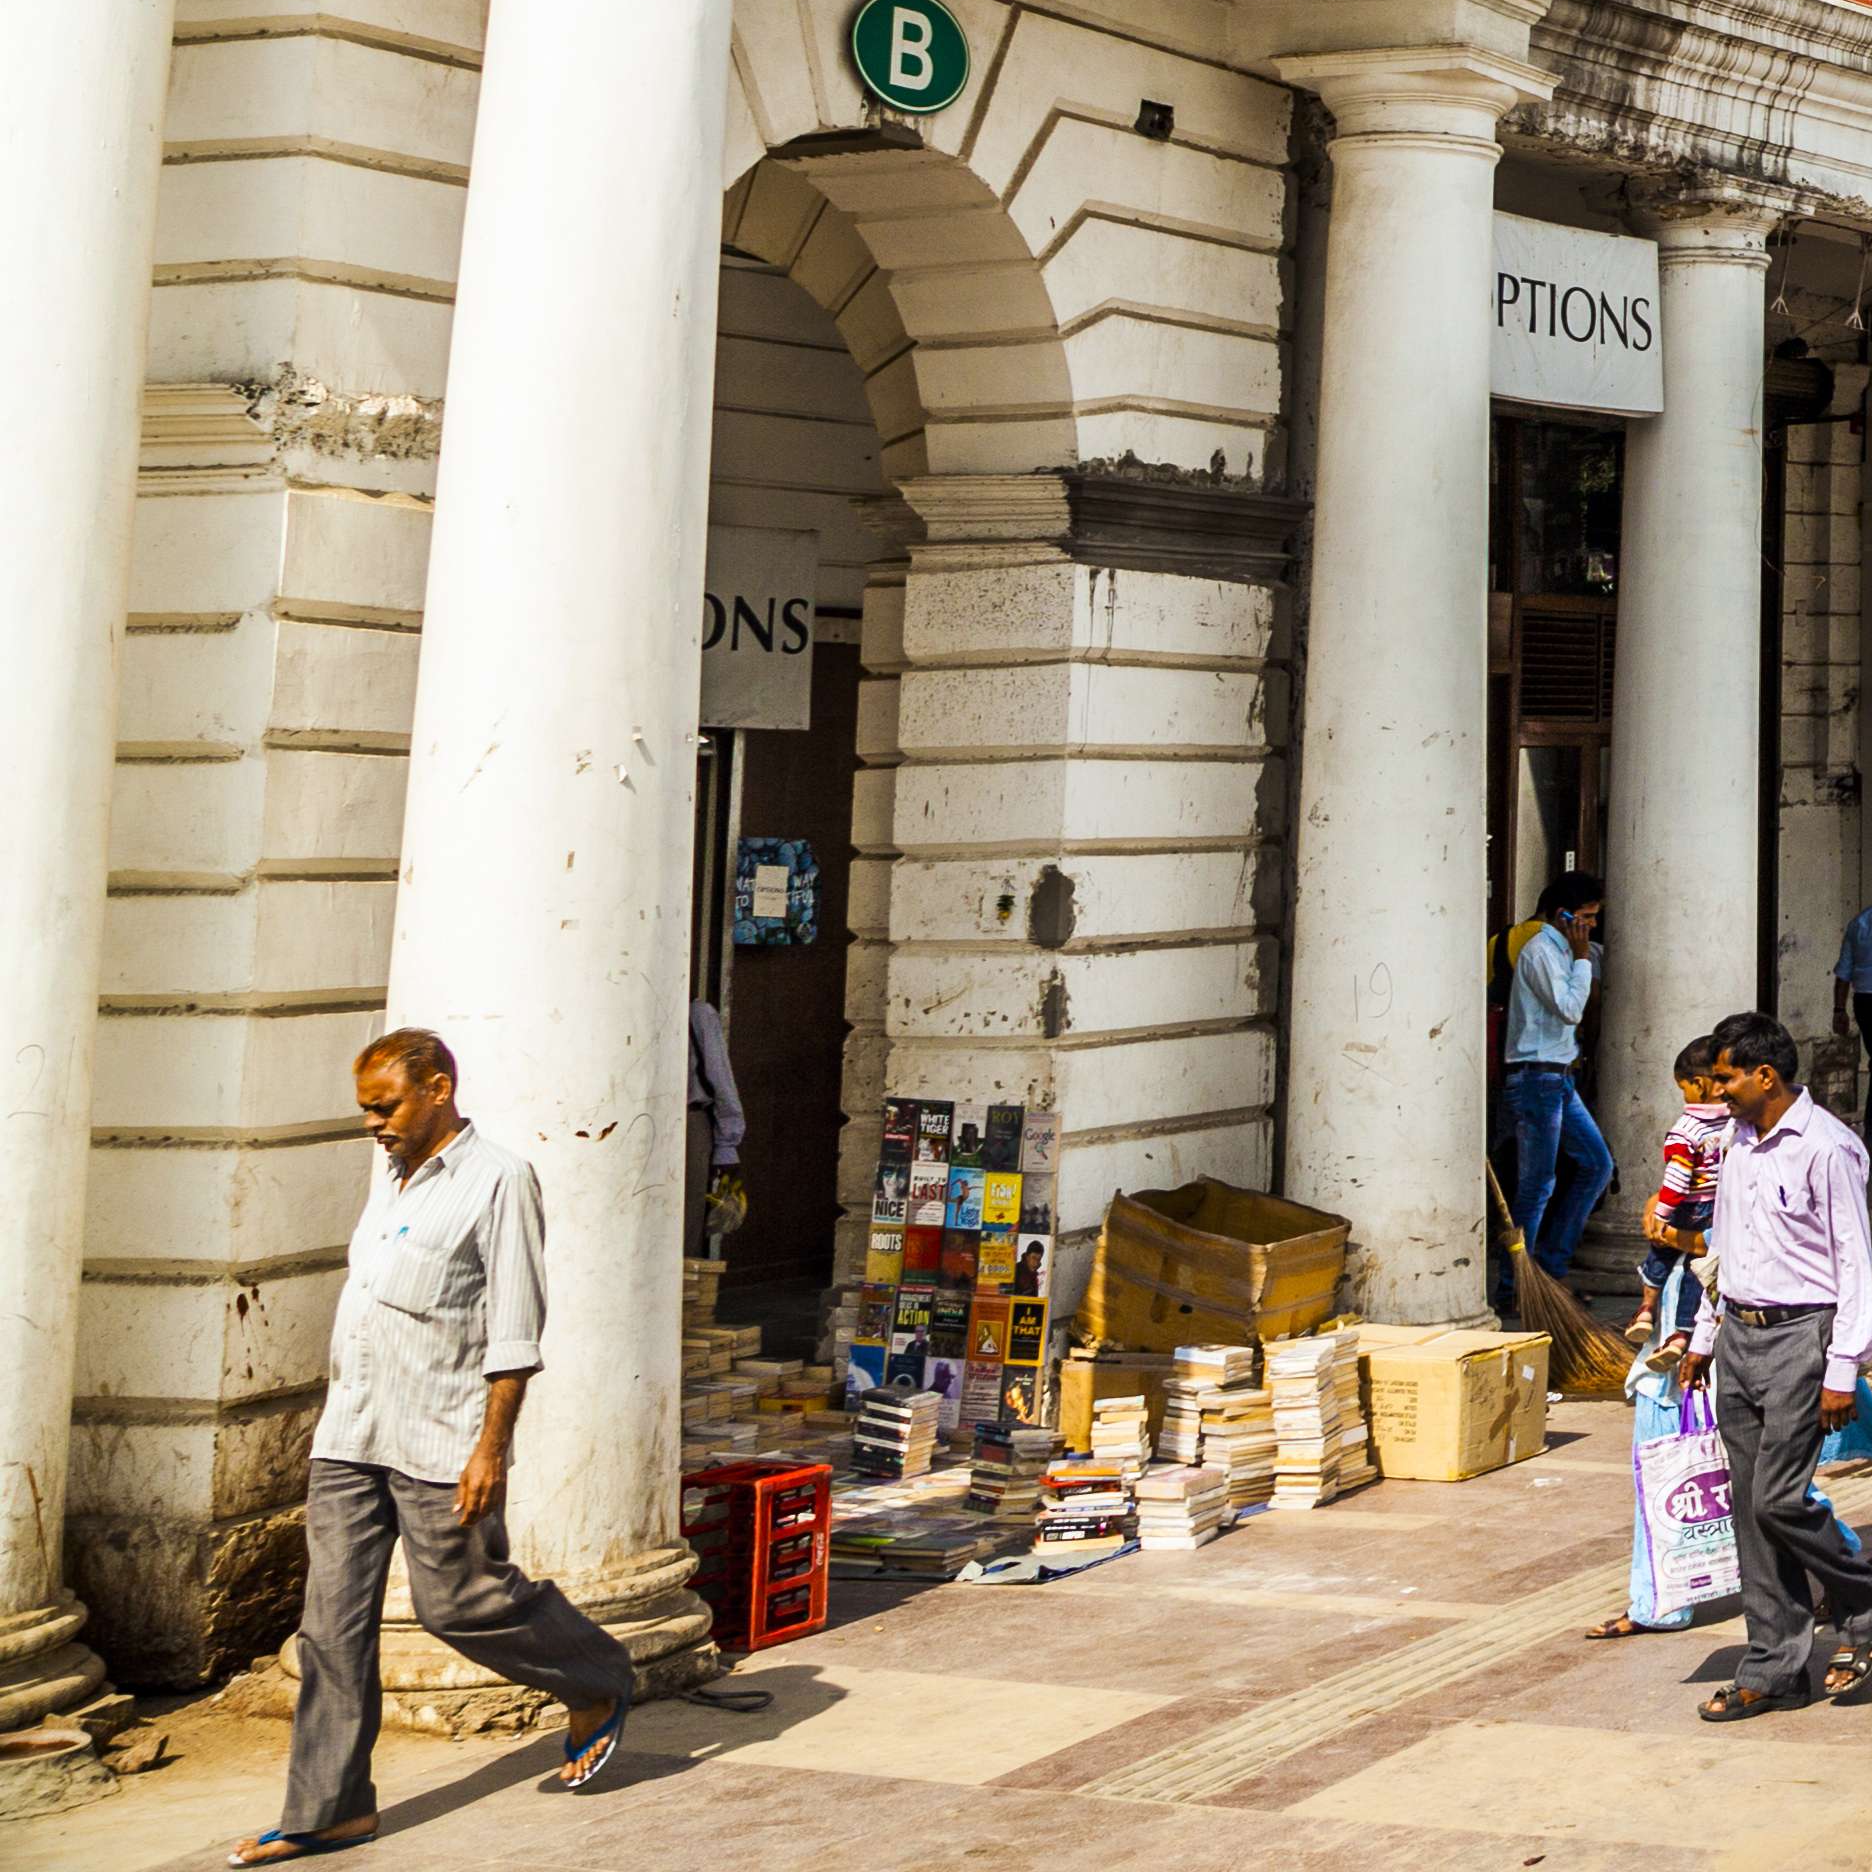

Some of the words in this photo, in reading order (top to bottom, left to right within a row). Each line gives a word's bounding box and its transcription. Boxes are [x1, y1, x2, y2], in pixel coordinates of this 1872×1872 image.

[888, 4, 934, 92] B
[1491, 271, 1653, 352] PTIONS
[920, 1113, 950, 1126] WHITE
[920, 1123, 949, 1135] TIGER
[1023, 1128, 1056, 1145] Google
[912, 1183, 945, 1201] LAST
[874, 1200, 905, 1218] NICE
[871, 1233, 902, 1251] ROOTS
[896, 1310, 930, 1326] ACTION
[1018, 1315, 1037, 1325] AM
[1013, 1324, 1041, 1336] THAT
